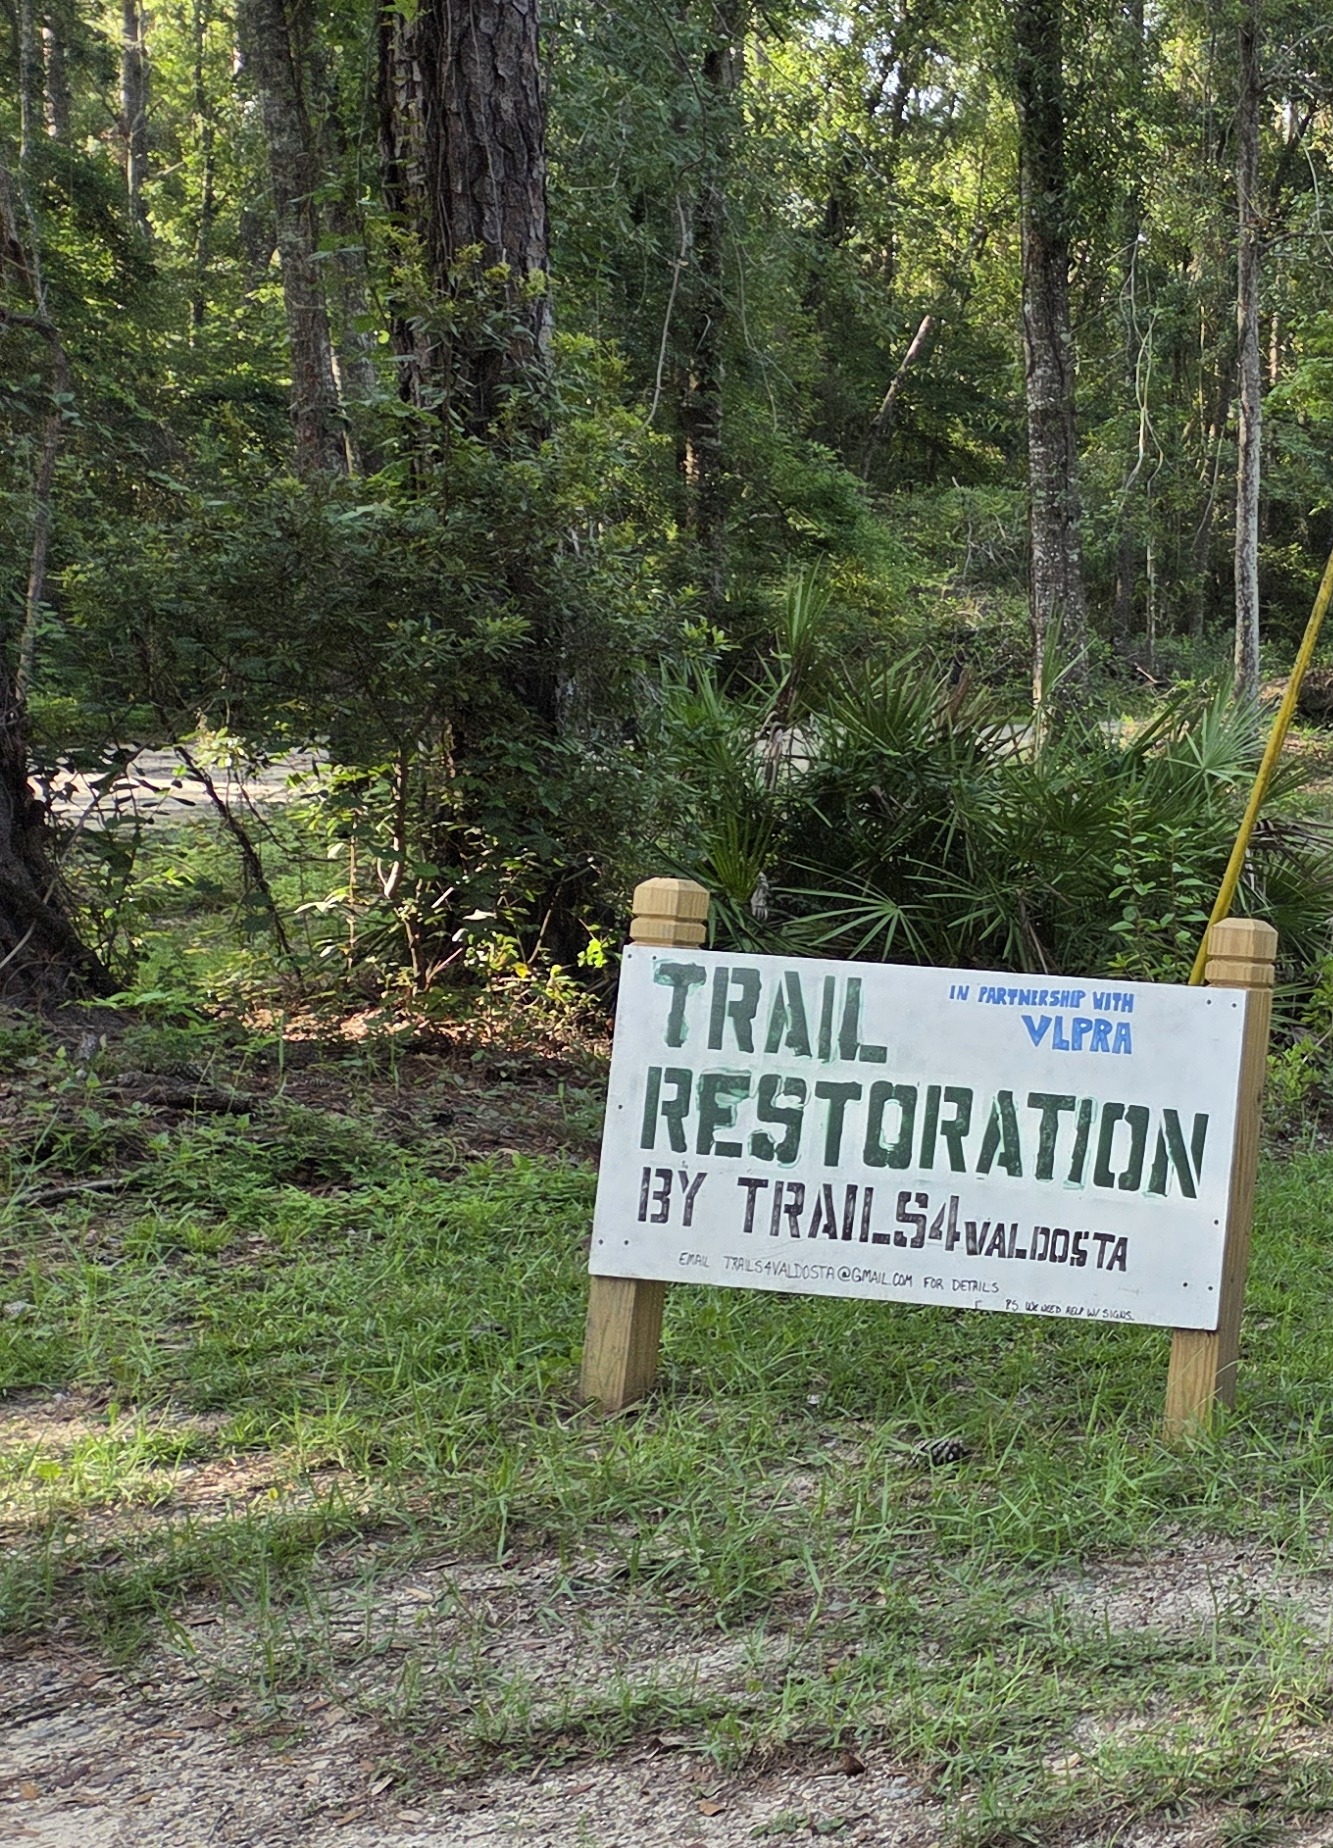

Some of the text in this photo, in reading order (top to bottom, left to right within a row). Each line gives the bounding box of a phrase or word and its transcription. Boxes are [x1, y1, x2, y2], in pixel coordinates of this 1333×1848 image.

[654, 961, 888, 1063] TRAIL
[950, 985, 1135, 1013] IN PARTNERSHIP WITH
[1021, 1015, 1132, 1054] VLPRA
[640, 1065, 1210, 1199] RESTORATION
[637, 1167, 707, 1227] BY
[678, 1252, 710, 1268] EMAIL
[923, 1277, 944, 1290] FOR
[952, 1279, 1000, 1294] DETAILS
